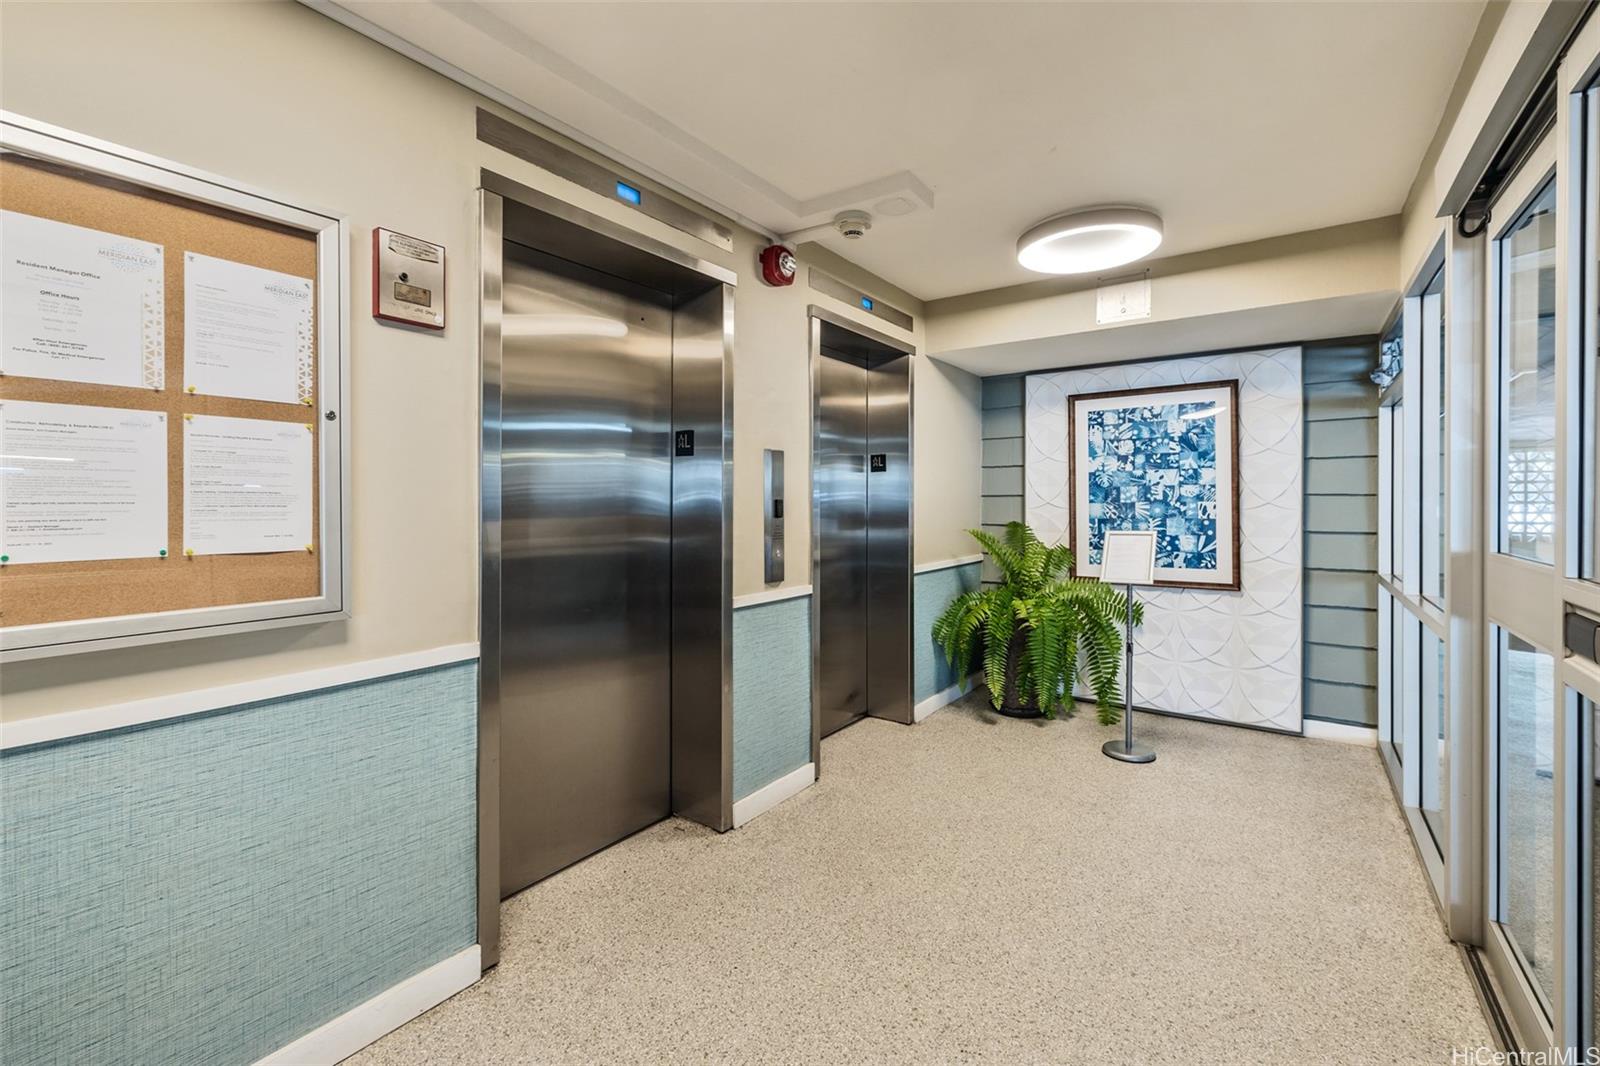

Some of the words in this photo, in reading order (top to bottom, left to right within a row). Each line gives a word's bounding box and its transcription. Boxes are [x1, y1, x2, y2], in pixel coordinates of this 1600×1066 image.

[16, 259, 48, 269] Resident
[49, 265, 80, 275] Manager
[80, 271, 101, 280] Office
[39, 289, 60, 298] Office
